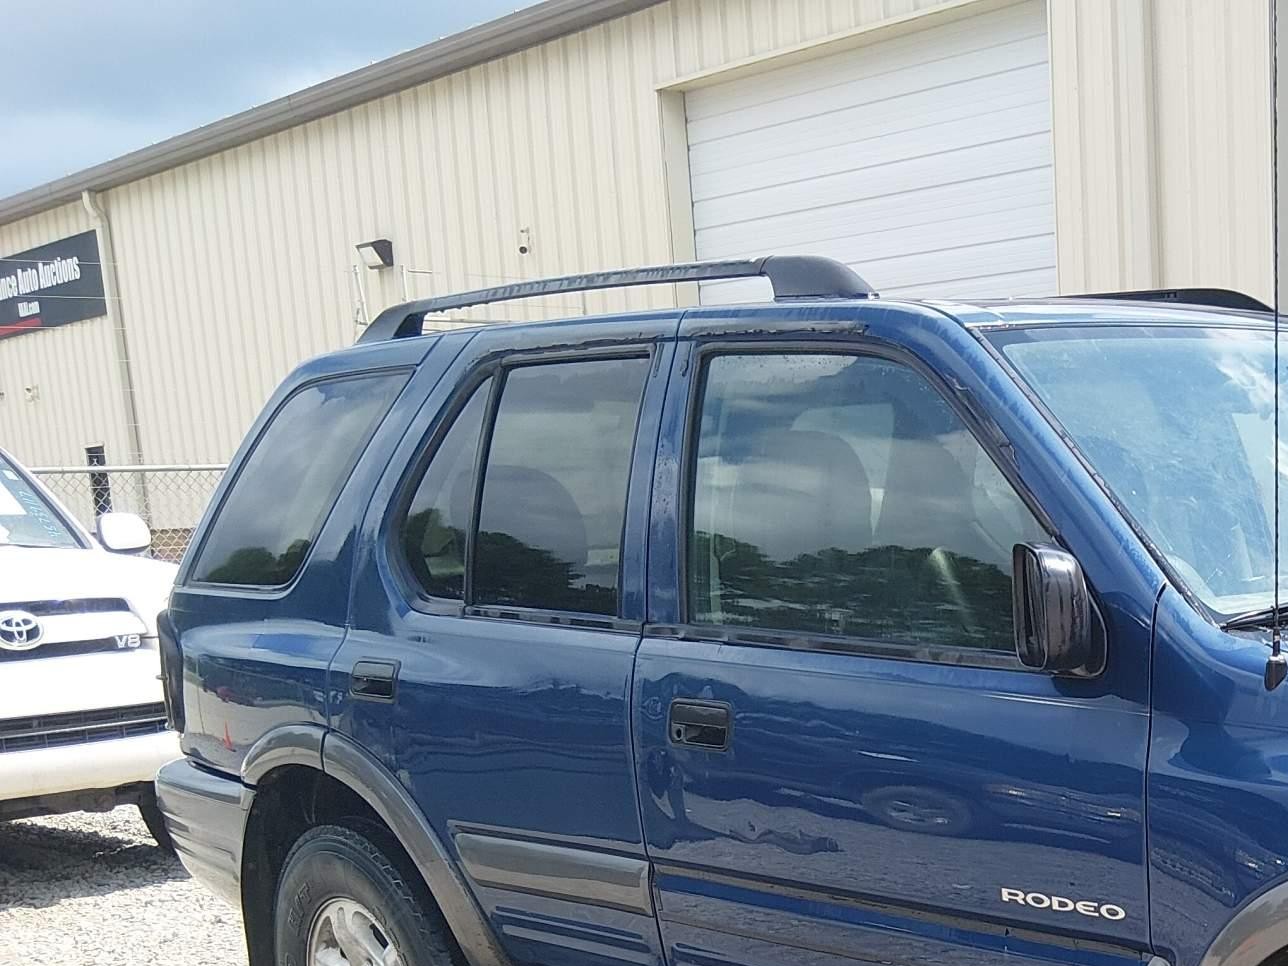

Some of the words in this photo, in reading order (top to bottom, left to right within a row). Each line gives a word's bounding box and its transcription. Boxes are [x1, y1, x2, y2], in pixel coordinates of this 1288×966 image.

[17, 268, 39, 294] Auto
[38, 256, 81, 289] Auctions
[115, 635, 141, 648] V8
[1001, 888, 1126, 920] RODEO
